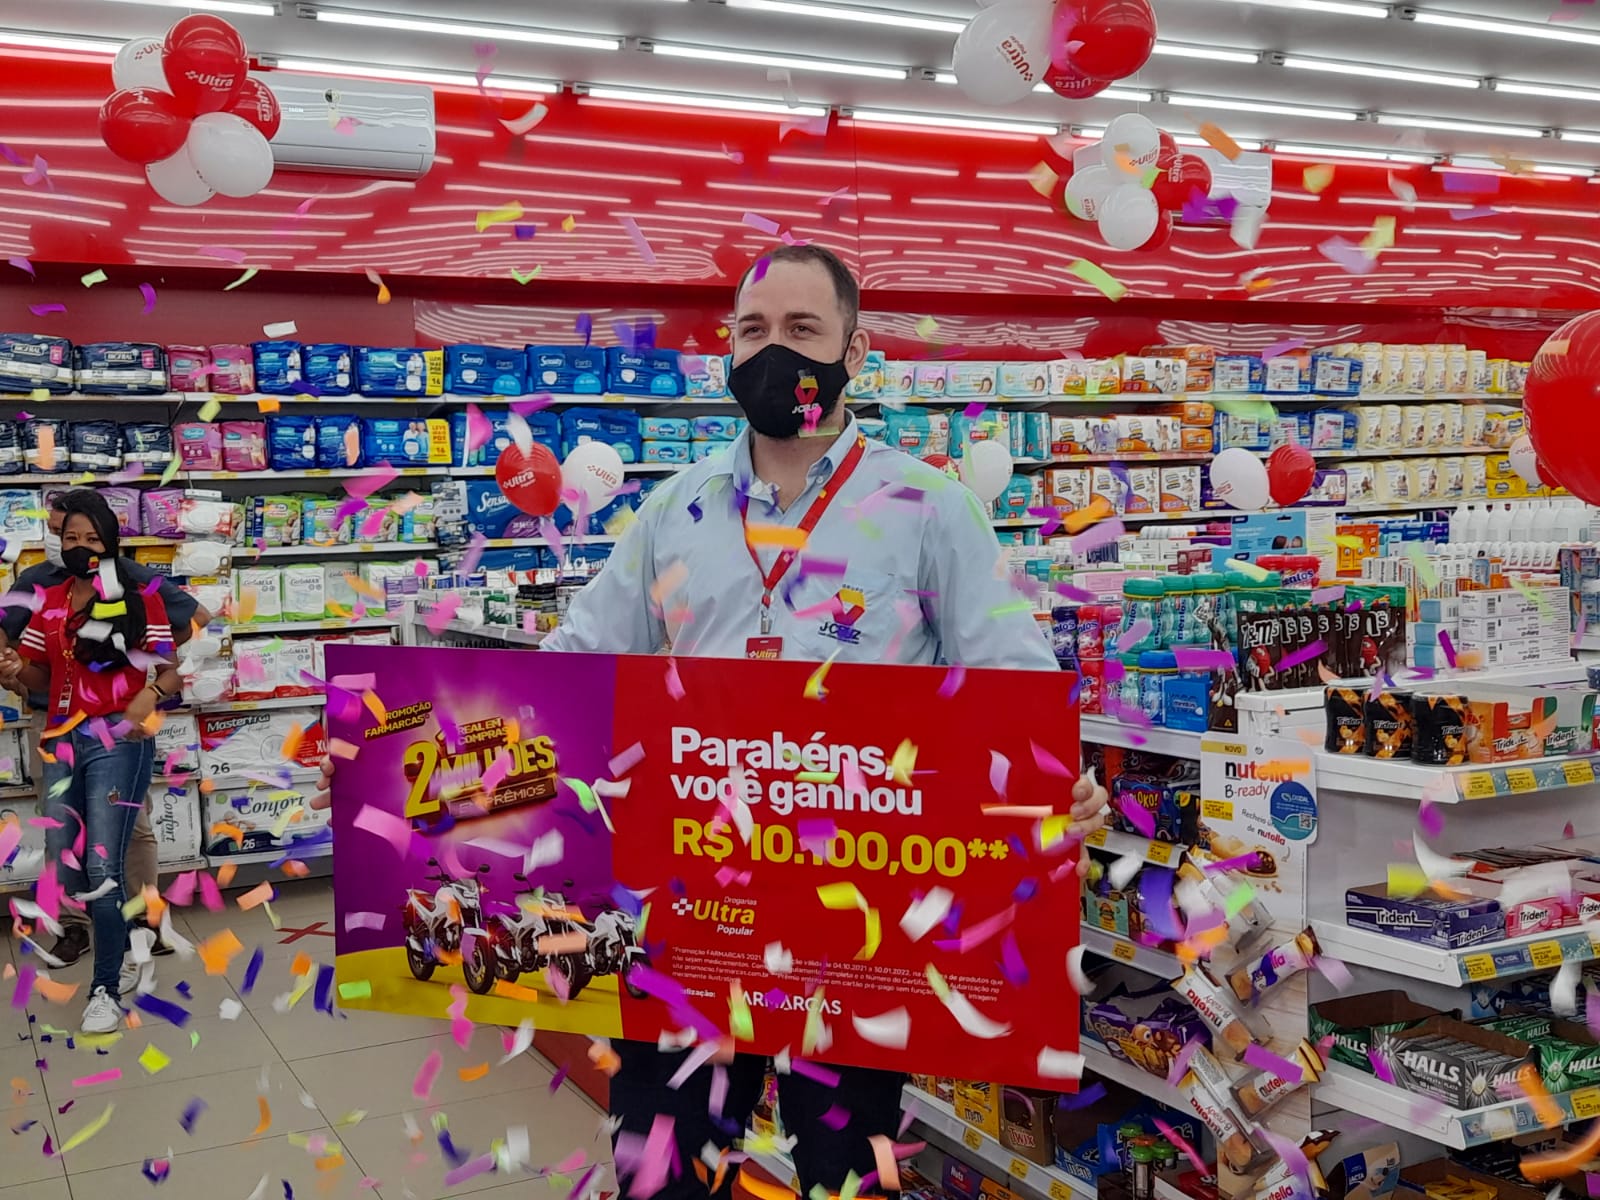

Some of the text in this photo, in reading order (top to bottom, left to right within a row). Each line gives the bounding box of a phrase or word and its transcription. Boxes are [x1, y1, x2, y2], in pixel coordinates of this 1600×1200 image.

[1001, 39, 1031, 76] Ultra
[198, 73, 233, 87] Ultra
[508, 471, 535, 487] Ultra
[595, 468, 618, 486] Ultra
[477, 491, 510, 512] Sensa
[1177, 599, 1186, 640] mentos
[820, 622, 861, 640] JCZ
[486, 718, 502, 730] EM
[1546, 729, 1577, 744] Trident
[671, 726, 894, 781] Parabéns,
[1224, 744, 1242, 754] NOVO
[210, 762, 231, 775] 26
[403, 740, 440, 818] 2
[670, 770, 922, 816] você ganhou
[1224, 782, 1270, 800] B-ready
[1241, 808, 1267, 824] Recheio
[243, 839, 256, 849] 26
[673, 817, 734, 863] R$
[1247, 824, 1286, 846] de nutella
[693, 898, 755, 924] Ultra
[1376, 909, 1417, 926] Trident
[1520, 909, 1548, 922] Trident
[716, 924, 754, 936] Popular
[1456, 927, 1489, 946] Trident
[1186, 988, 1222, 1028] nutella
[1526, 1024, 1550, 1039] HALLS
[1331, 1031, 1368, 1053] HALLS
[1402, 1050, 1459, 1083] HALLS
[1493, 1067, 1531, 1087] HALLS
[1190, 1097, 1224, 1139] nutella
[1351, 1172, 1365, 1183] ACTA
